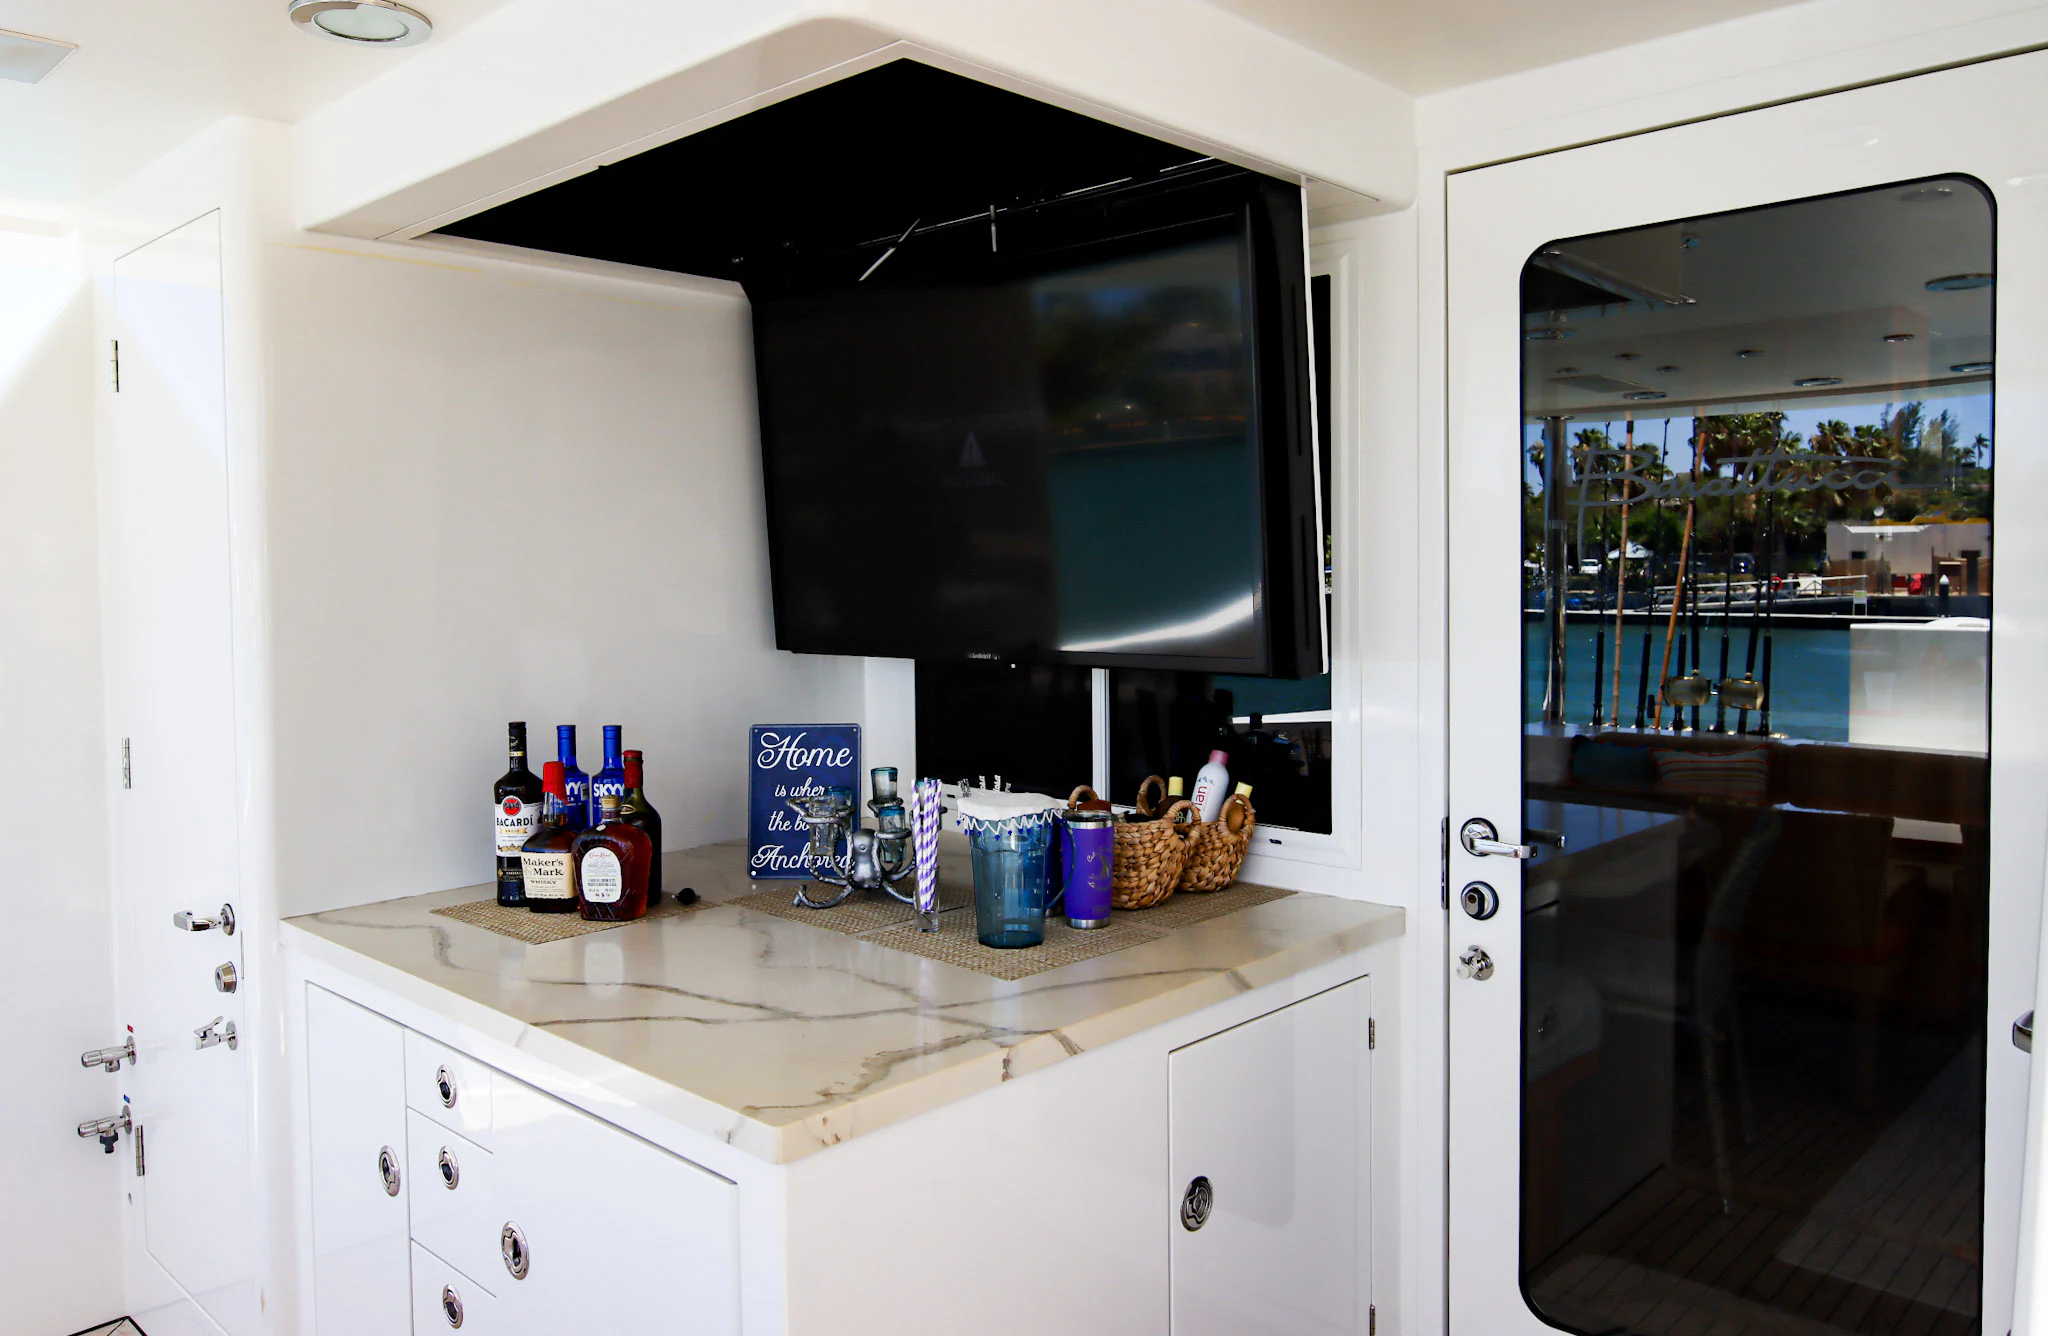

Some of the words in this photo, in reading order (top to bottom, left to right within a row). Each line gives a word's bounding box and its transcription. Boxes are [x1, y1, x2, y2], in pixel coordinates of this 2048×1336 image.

[1567, 447, 1942, 560] Barattucci
[757, 732, 853, 770] Home
[593, 783, 625, 797] SKYY
[774, 783, 787, 797] is
[790, 776, 825, 797] wher
[768, 810, 792, 831] the
[794, 813, 811, 831] bo
[522, 857, 564, 867] Maker's
[533, 867, 564, 876] Mark
